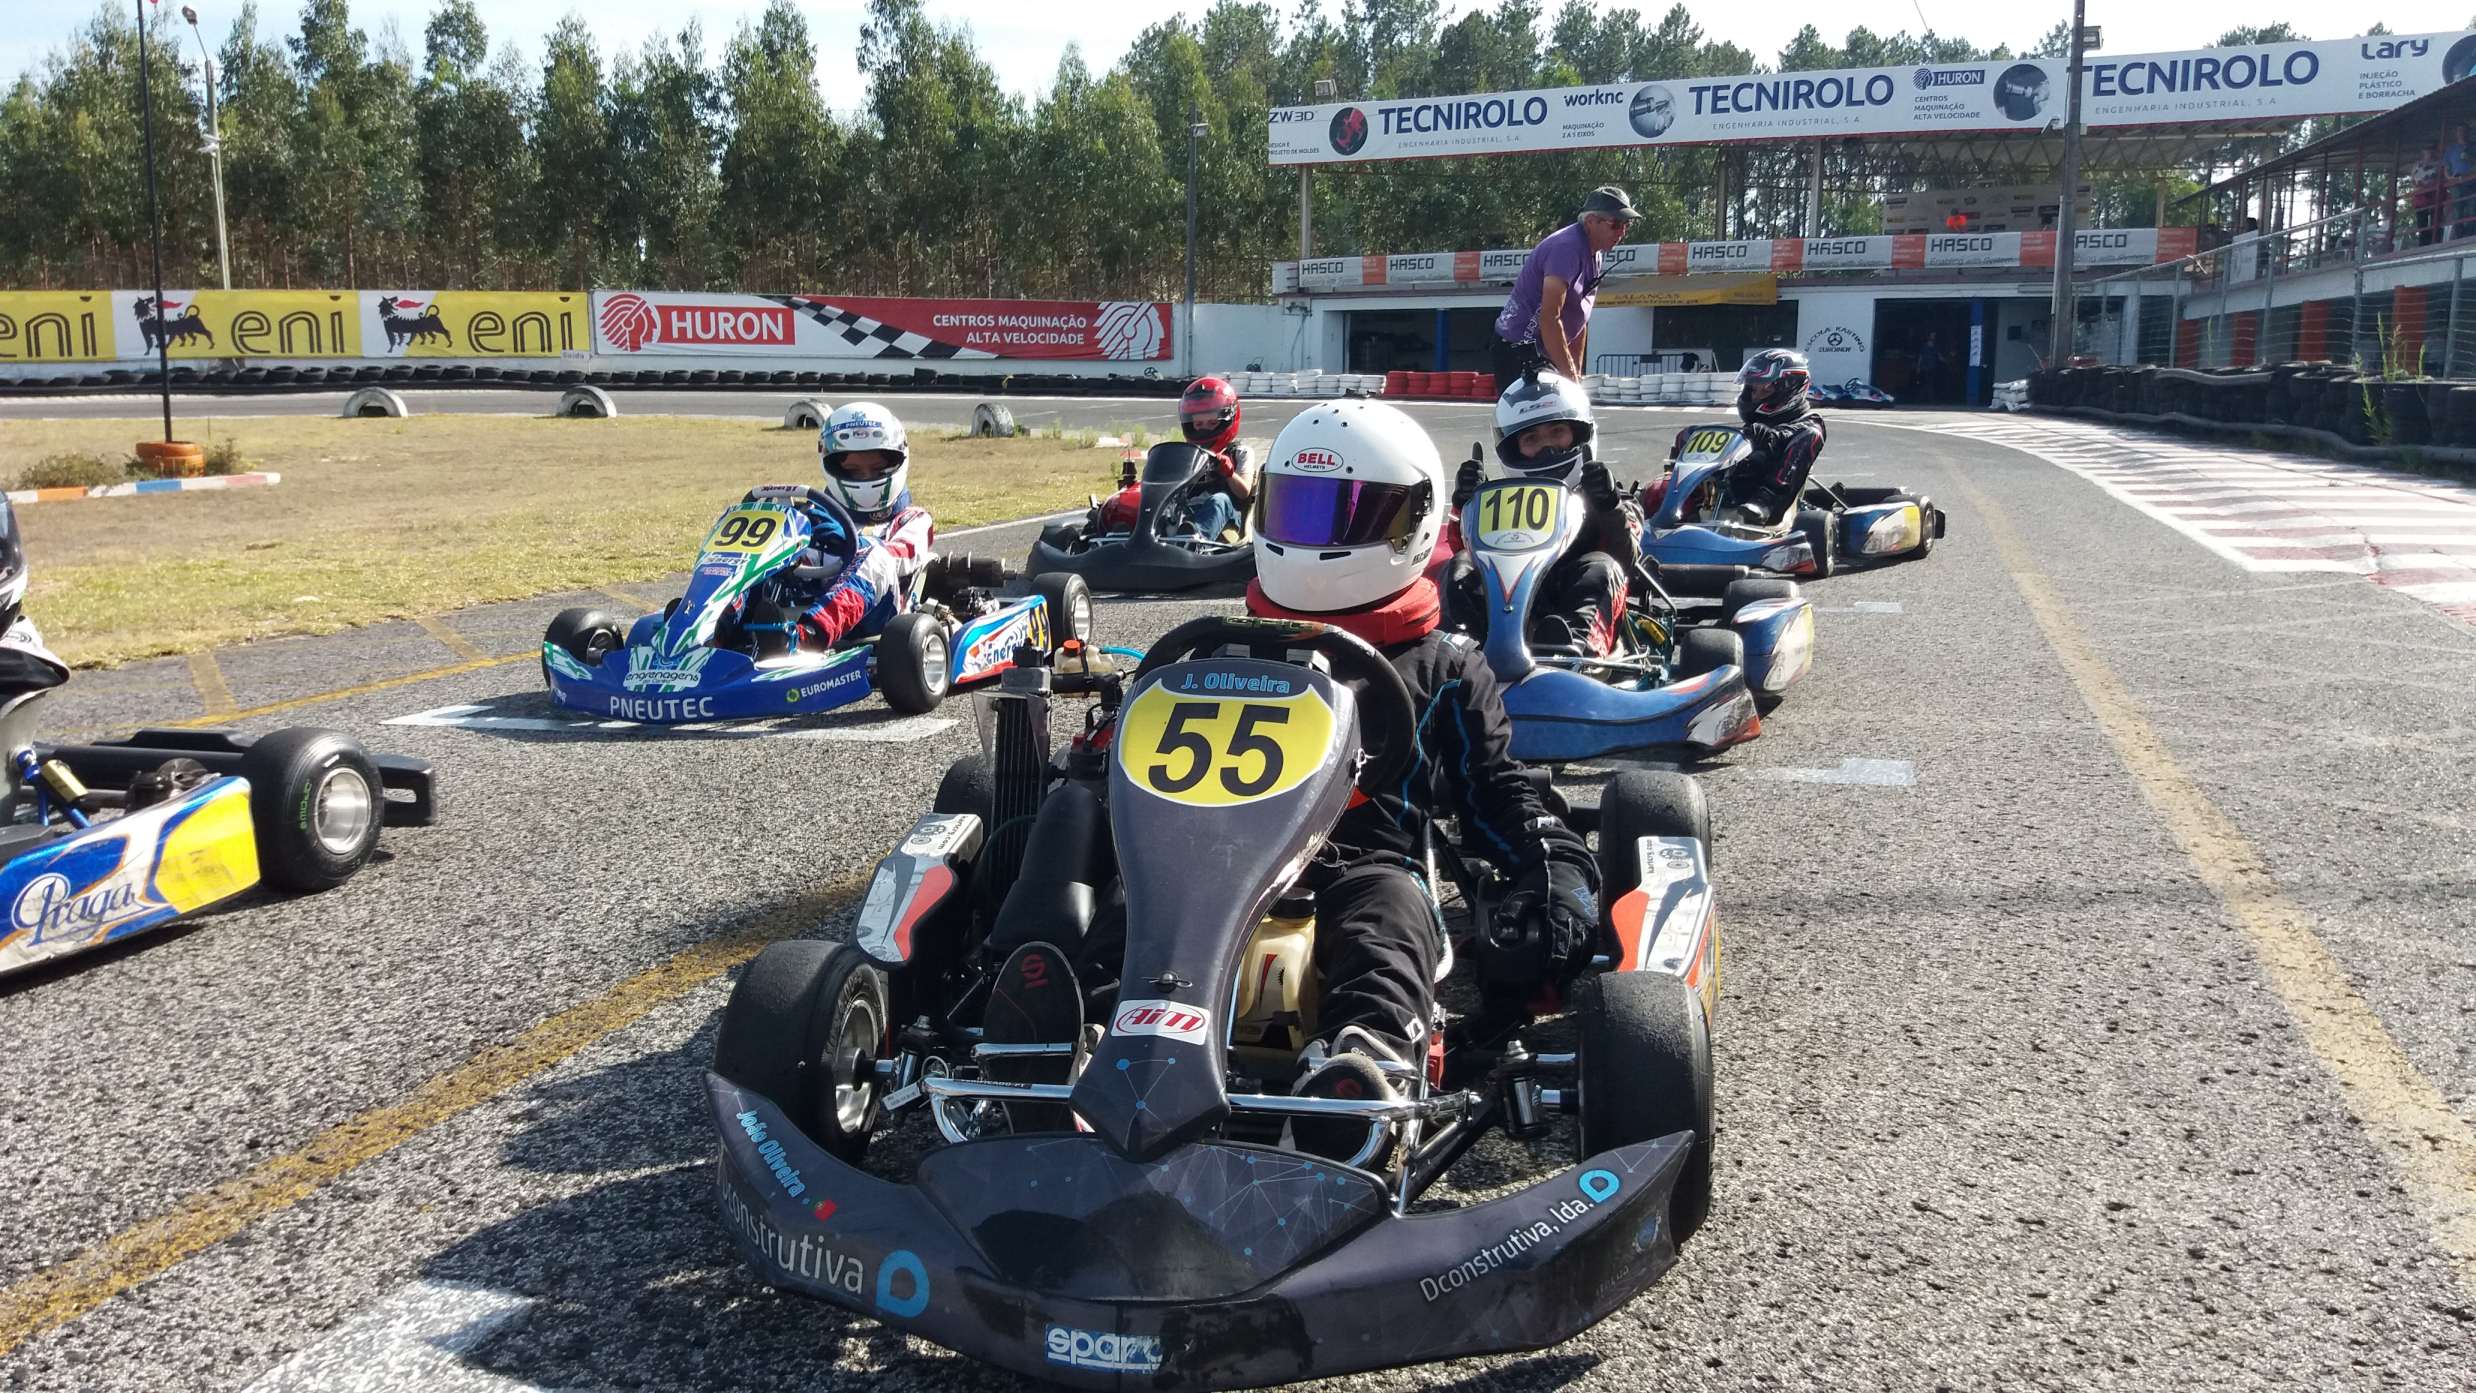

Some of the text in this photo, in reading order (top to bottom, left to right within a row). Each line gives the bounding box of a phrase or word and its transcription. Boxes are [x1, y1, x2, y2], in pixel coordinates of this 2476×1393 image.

[1937, 71, 1981, 84] HURON
[2360, 70, 2399, 79] INJEÇÃO
[2359, 80, 2402, 89] PLÁSTICO
[1564, 89, 1624, 107] worknc
[1689, 75, 1894, 115] TECNIROLO
[2366, 89, 2416, 99] BORRACHA
[1914, 103, 1965, 112] MAQUINAÇÃO
[2095, 103, 2169, 114] ENGENHARIA
[2176, 100, 2250, 110] INDUSTRIAL,
[1269, 111, 1315, 123] ZW3D
[1378, 97, 1548, 135] TECNIROLO
[1562, 121, 1605, 131] MAQUINAÇÃO
[1713, 120, 1774, 130] ENGENHARIA
[1398, 137, 1448, 149] ENGENHARIA
[1807, 240, 1867, 256] HASCO
[1930, 237, 1993, 252] HASCO
[2075, 234, 2128, 249] ASCO
[1602, 249, 1636, 263] SCO
[1692, 245, 1748, 260] HASCO
[1302, 261, 1344, 276] HASCO
[1389, 257, 1435, 271] HASCO
[231, 294, 346, 354] eni
[467, 295, 574, 353] eni
[671, 310, 784, 341] HURON
[933, 313, 1087, 331] CENTROS MAQUINAÇÃO
[966, 332, 1085, 345] ALTA VELOCIDADE
[1687, 431, 1730, 454] 109
[1297, 453, 1336, 466] BELL
[1485, 487, 1550, 531] 110
[714, 516, 777, 547] 99
[625, 670, 699, 682] engrenagens
[800, 669, 862, 698] EUROMASTER
[1181, 672, 1290, 694] J. Oliveira
[609, 695, 715, 720] PNEUTEC
[1148, 702, 1290, 797] 55
[11, 873, 152, 947] Praga
[736, 1110, 806, 1198] João Oliveira
[1419, 1219, 1560, 1302] Dconstrutiva,
[1550, 1198, 1595, 1224] lda.
[1047, 1327, 1164, 1366] sparc
